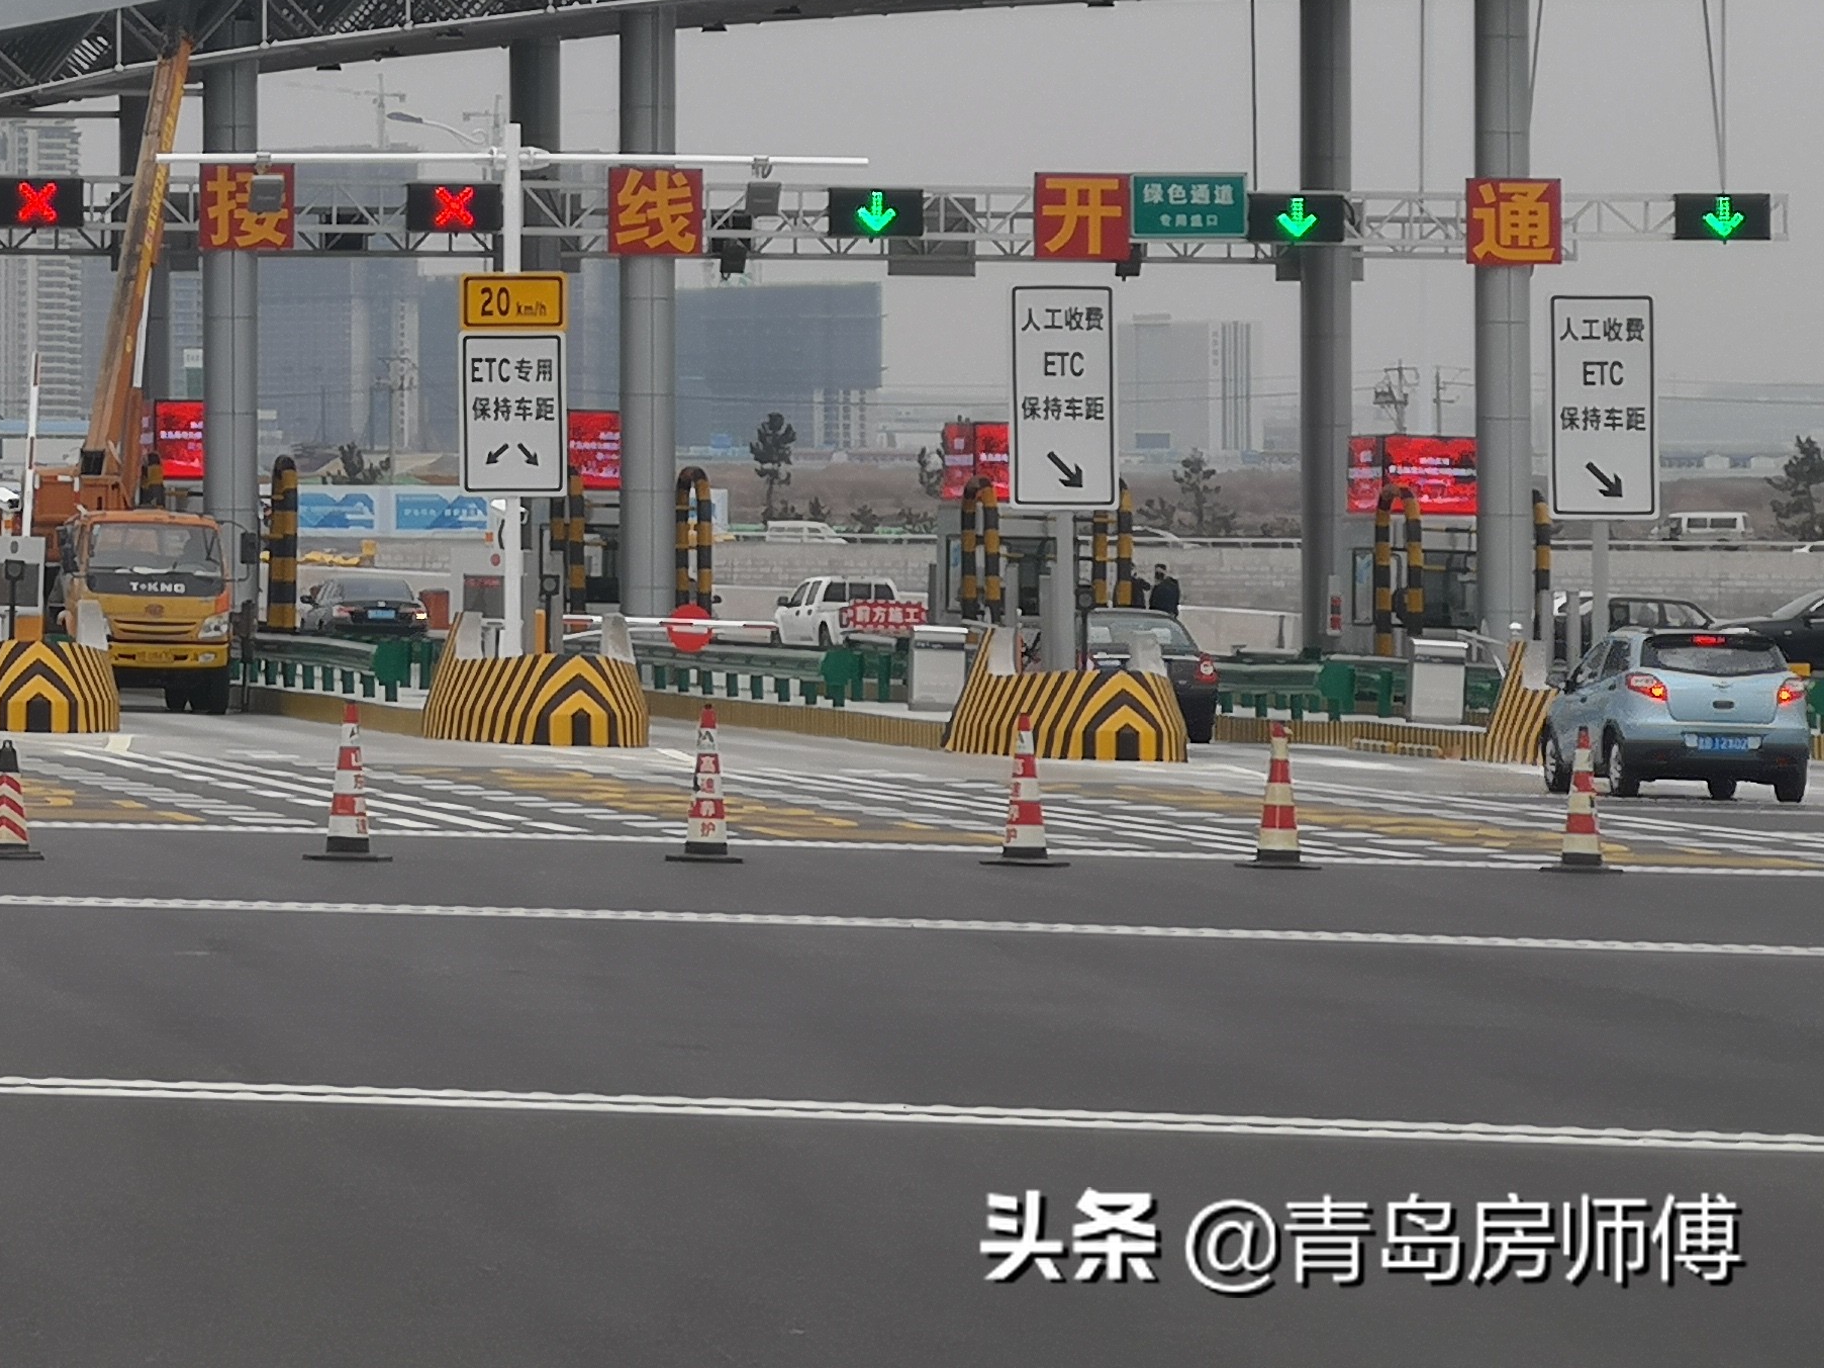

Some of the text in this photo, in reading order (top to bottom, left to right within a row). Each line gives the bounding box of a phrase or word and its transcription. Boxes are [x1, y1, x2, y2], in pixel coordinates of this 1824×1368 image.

[1142, 183, 1235, 205] 绿色通道
[207, 165, 287, 247] 接
[616, 171, 697, 254] 线
[1042, 178, 1123, 255] 开
[1472, 183, 1556, 262] 通
[480, 287, 547, 316] 20 km/h
[1021, 306, 1104, 331] 人工收费
[1559, 317, 1645, 342] 人工收费
[1044, 352, 1084, 376] ETC
[1582, 361, 1624, 386] ETC
[472, 396, 555, 421] 保持车距
[1021, 396, 1104, 421] 保持车距
[1560, 406, 1646, 431] 保持车距
